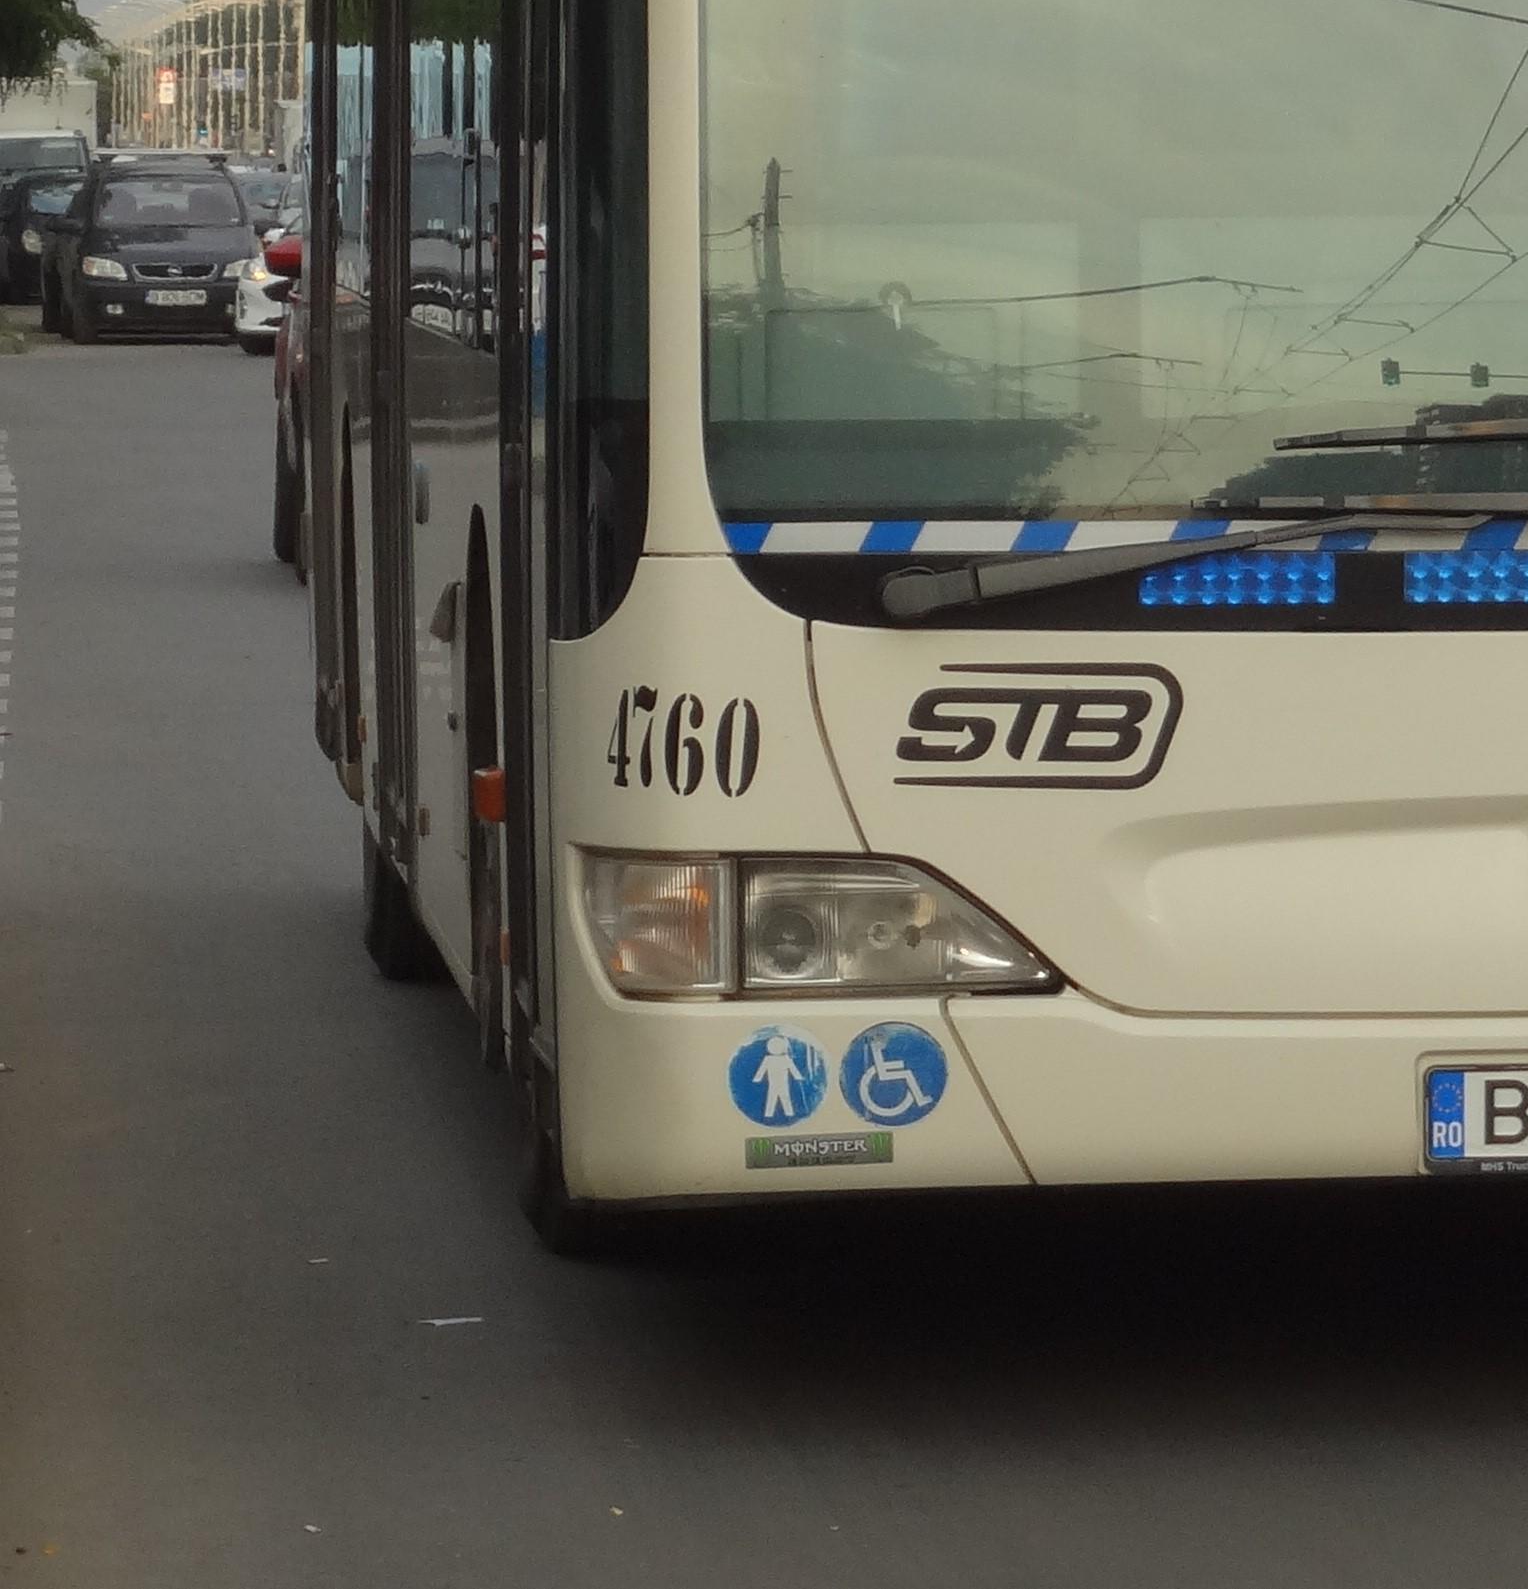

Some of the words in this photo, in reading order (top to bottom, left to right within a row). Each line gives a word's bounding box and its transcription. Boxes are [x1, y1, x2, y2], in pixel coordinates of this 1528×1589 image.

[607, 685, 760, 798] 4760
[896, 687, 1153, 762] STB
[1432, 1120, 1463, 1149] RO
